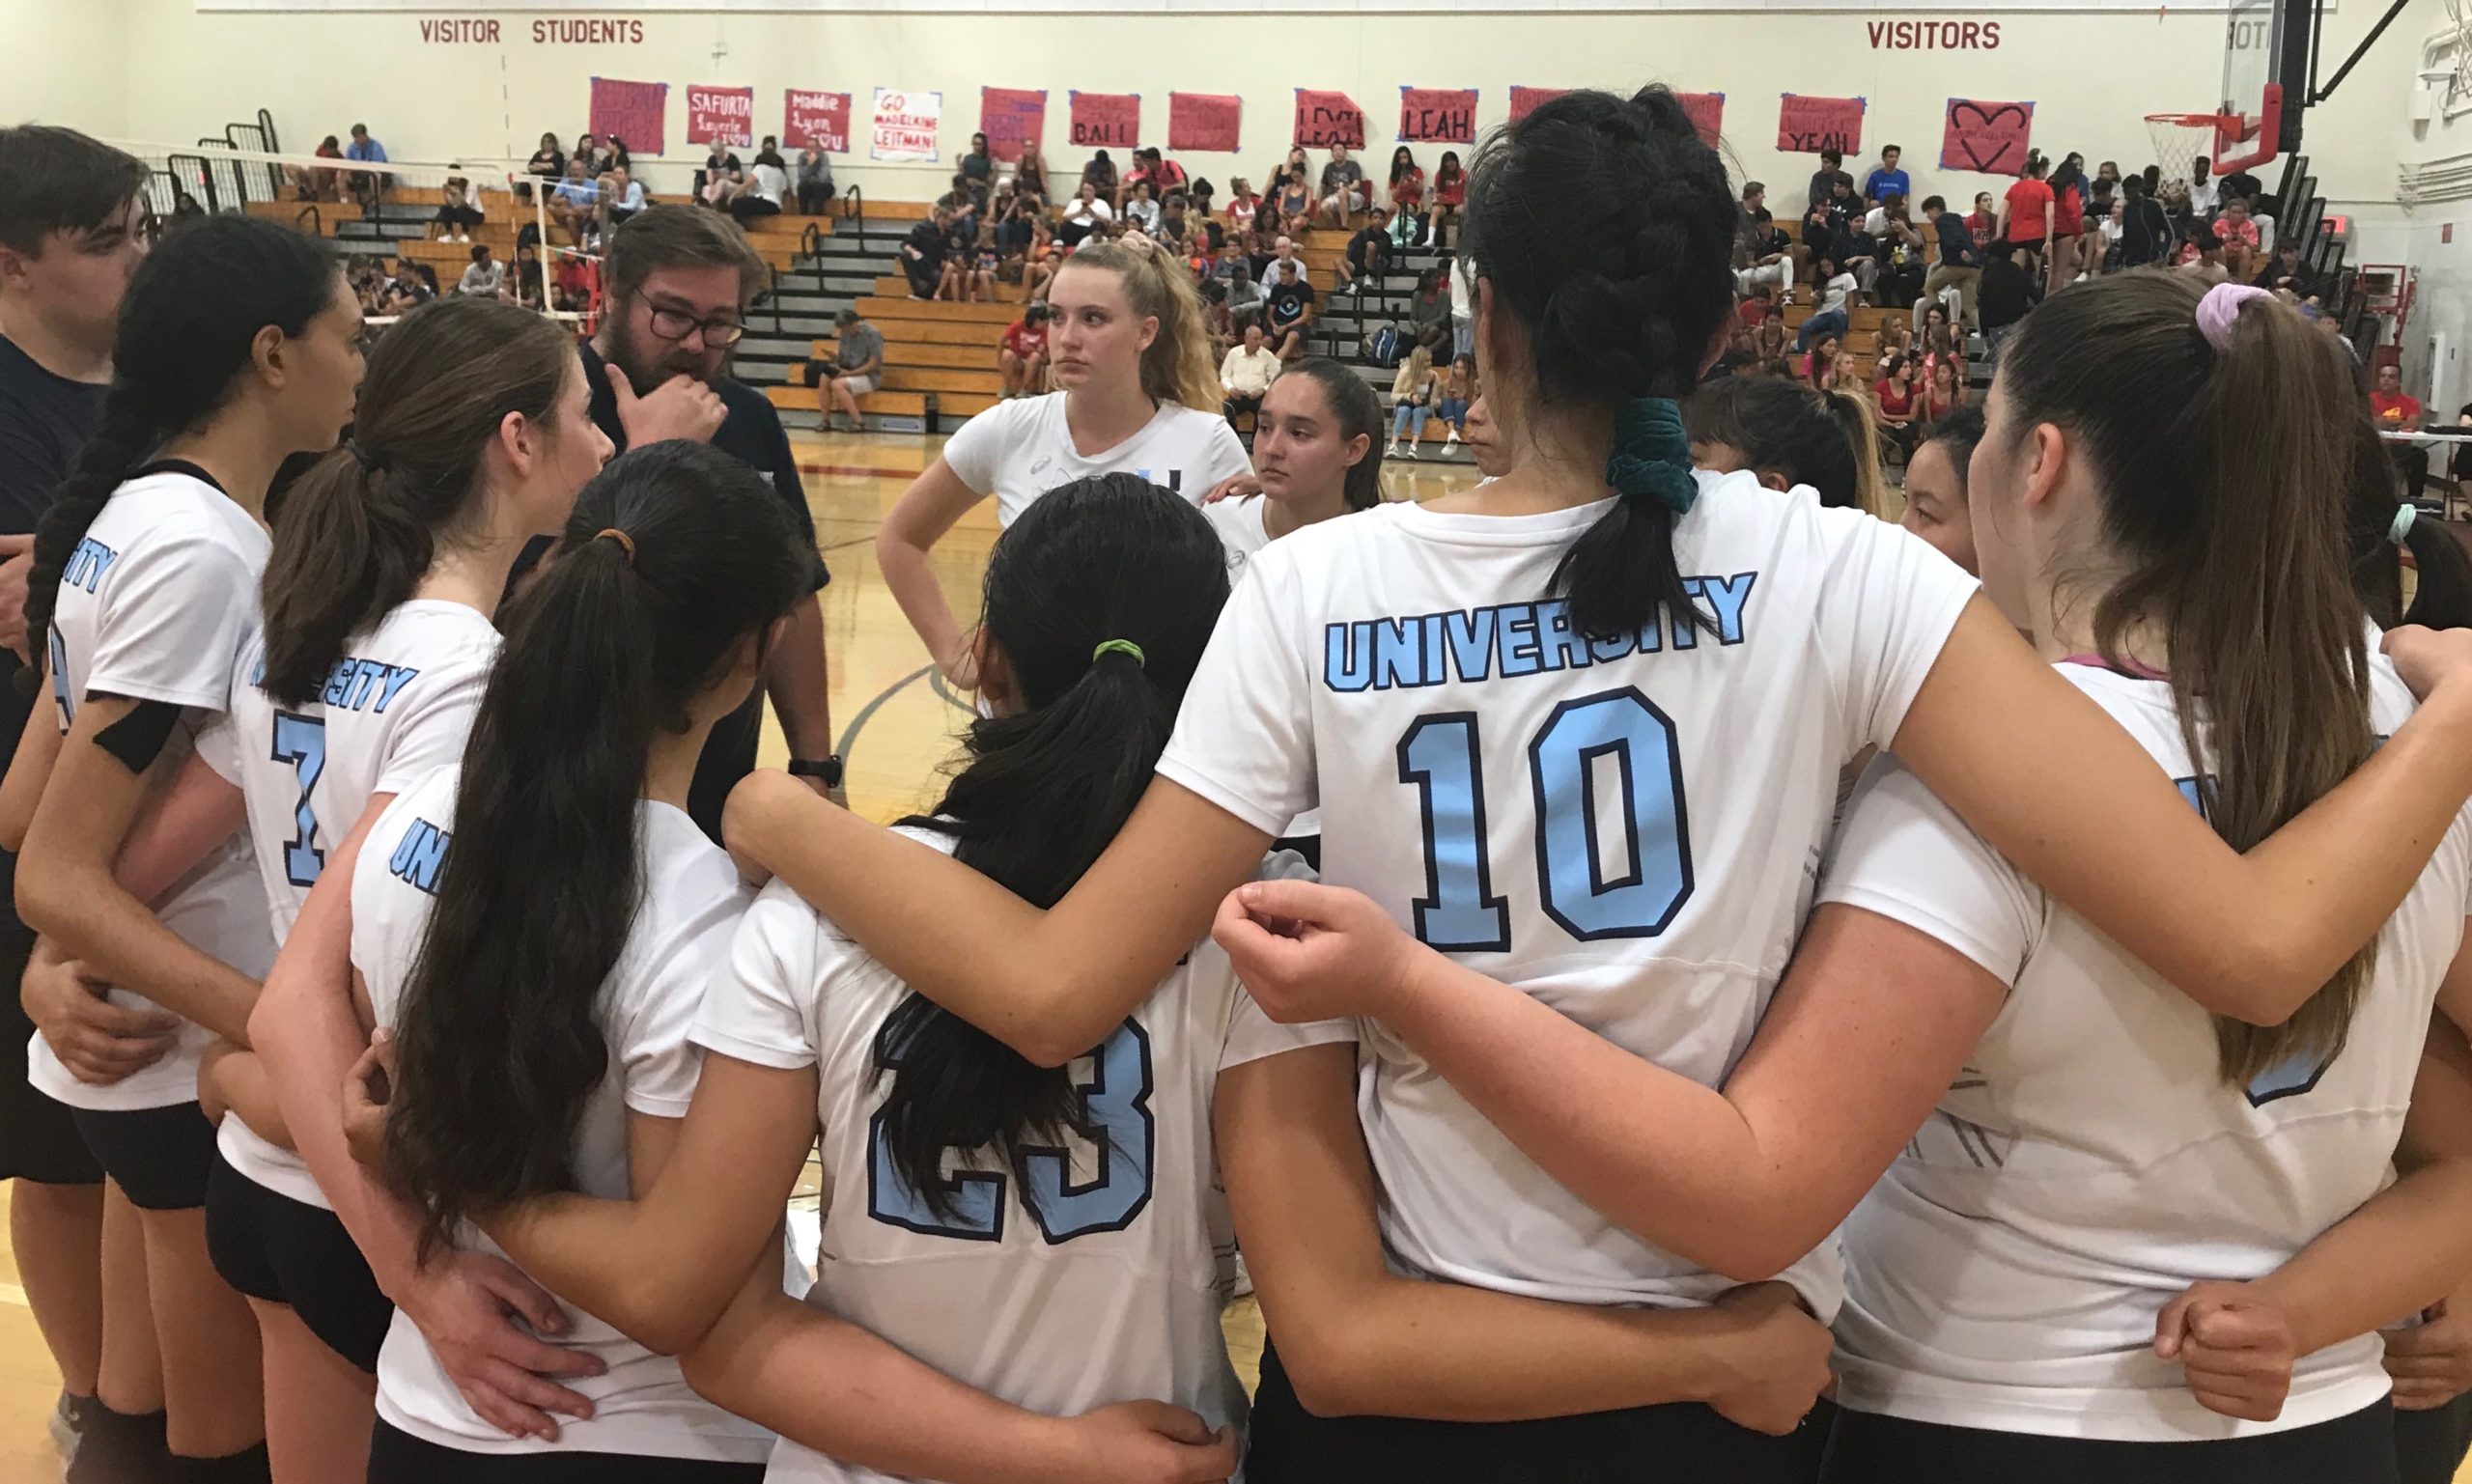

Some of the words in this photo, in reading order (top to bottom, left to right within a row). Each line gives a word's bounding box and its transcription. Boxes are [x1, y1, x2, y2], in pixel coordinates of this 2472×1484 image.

[419, 19, 500, 43] VISITOR
[532, 19, 643, 43] STUDENTS
[1867, 21, 2001, 49] VISITORS
[792, 93, 839, 111] Maddie
[881, 94, 906, 111] GO
[1404, 108, 1469, 139] LEAH
[1788, 131, 1848, 153] YEAH
[1395, 685, 1696, 954] 10
[867, 991, 1155, 1246] 23
